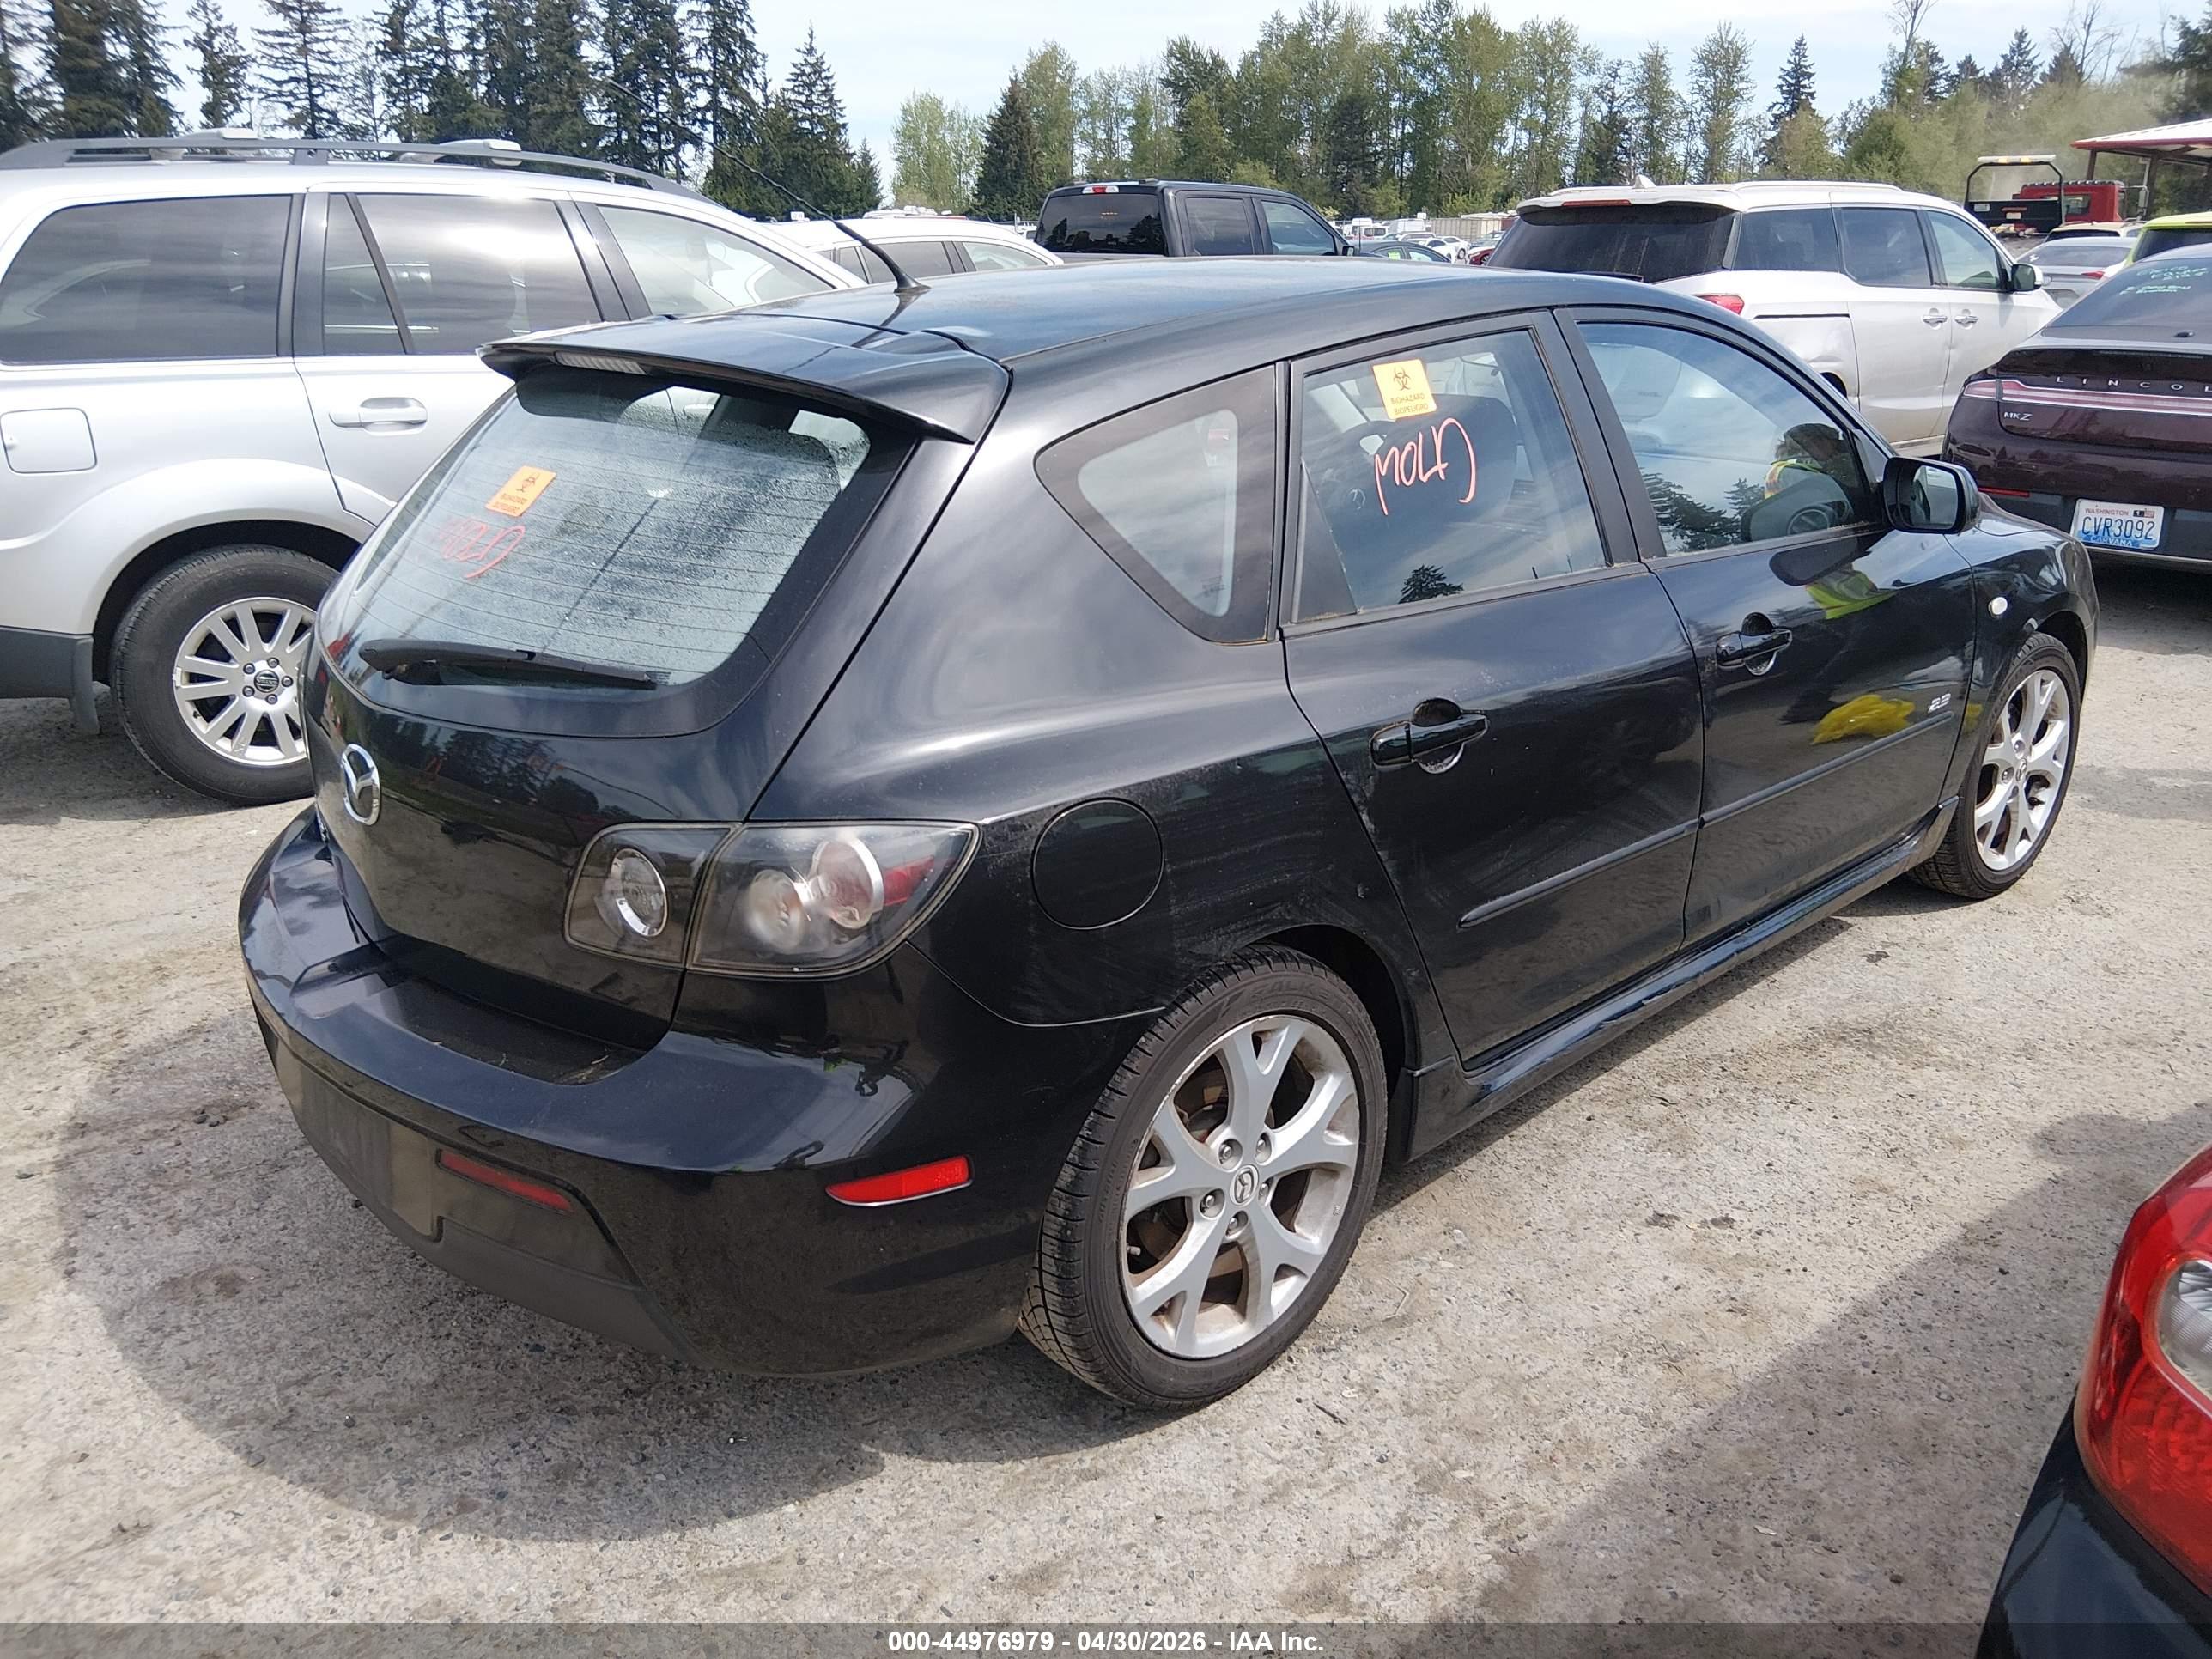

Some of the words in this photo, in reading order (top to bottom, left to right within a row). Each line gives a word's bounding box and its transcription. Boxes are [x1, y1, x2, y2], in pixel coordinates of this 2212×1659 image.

[1390, 392, 1425, 405] BIOHAZARD
[1394, 403, 1429, 415] BIOPELIGRO
[2003, 411, 2033, 421] MKZ
[1374, 417, 1478, 516] MOLD
[2084, 507, 2130, 517] WASHINGTON
[2081, 516, 2155, 541] CVR3092
[2090, 535, 2133, 547] CARVANA
